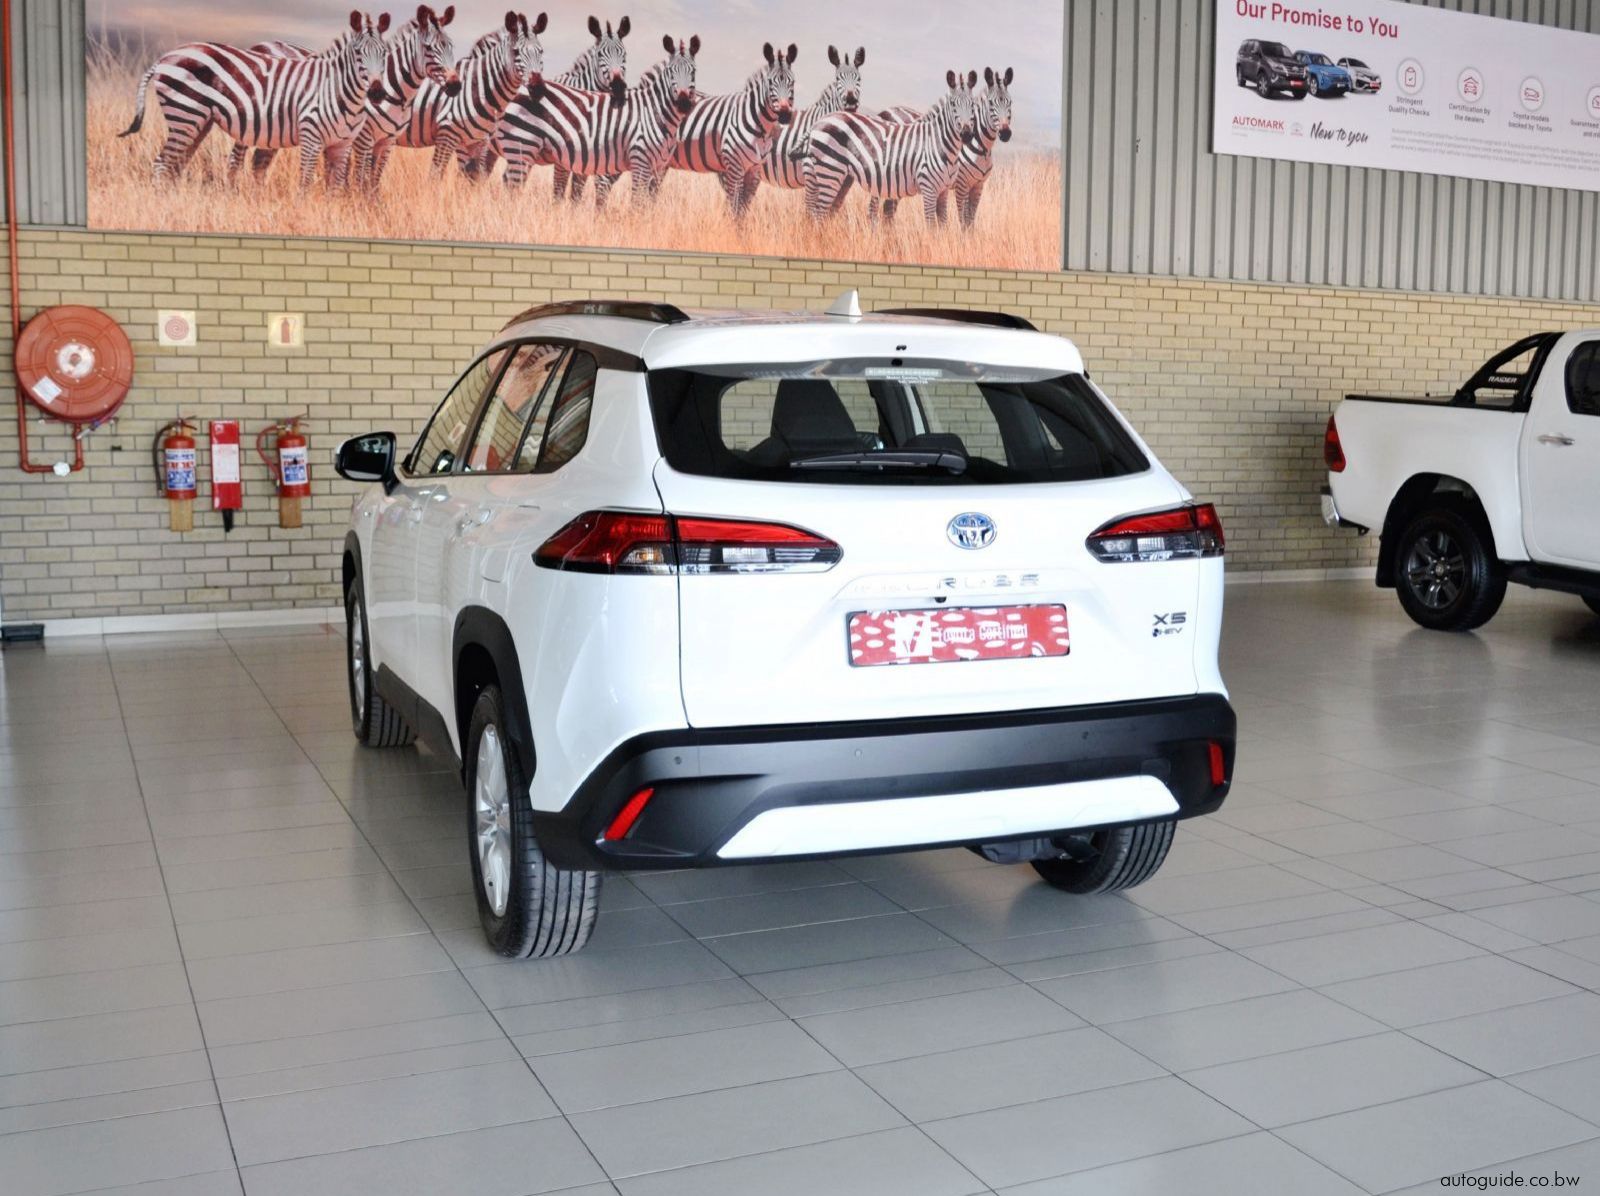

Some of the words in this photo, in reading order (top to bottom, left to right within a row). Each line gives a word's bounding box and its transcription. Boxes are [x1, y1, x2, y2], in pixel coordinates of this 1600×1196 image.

[1237, 0, 1266, 19] Our
[1271, 3, 1342, 30] Promise
[1347, 15, 1364, 33] to
[1369, 17, 1398, 38] You
[1396, 96, 1423, 106] Stringent
[1388, 105, 1408, 116] Quality
[1448, 103, 1483, 114] Certification
[1483, 108, 1491, 116] by
[1231, 116, 1285, 131] AUTOMARK
[1336, 127, 1346, 141] to
[1346, 130, 1369, 147] you
